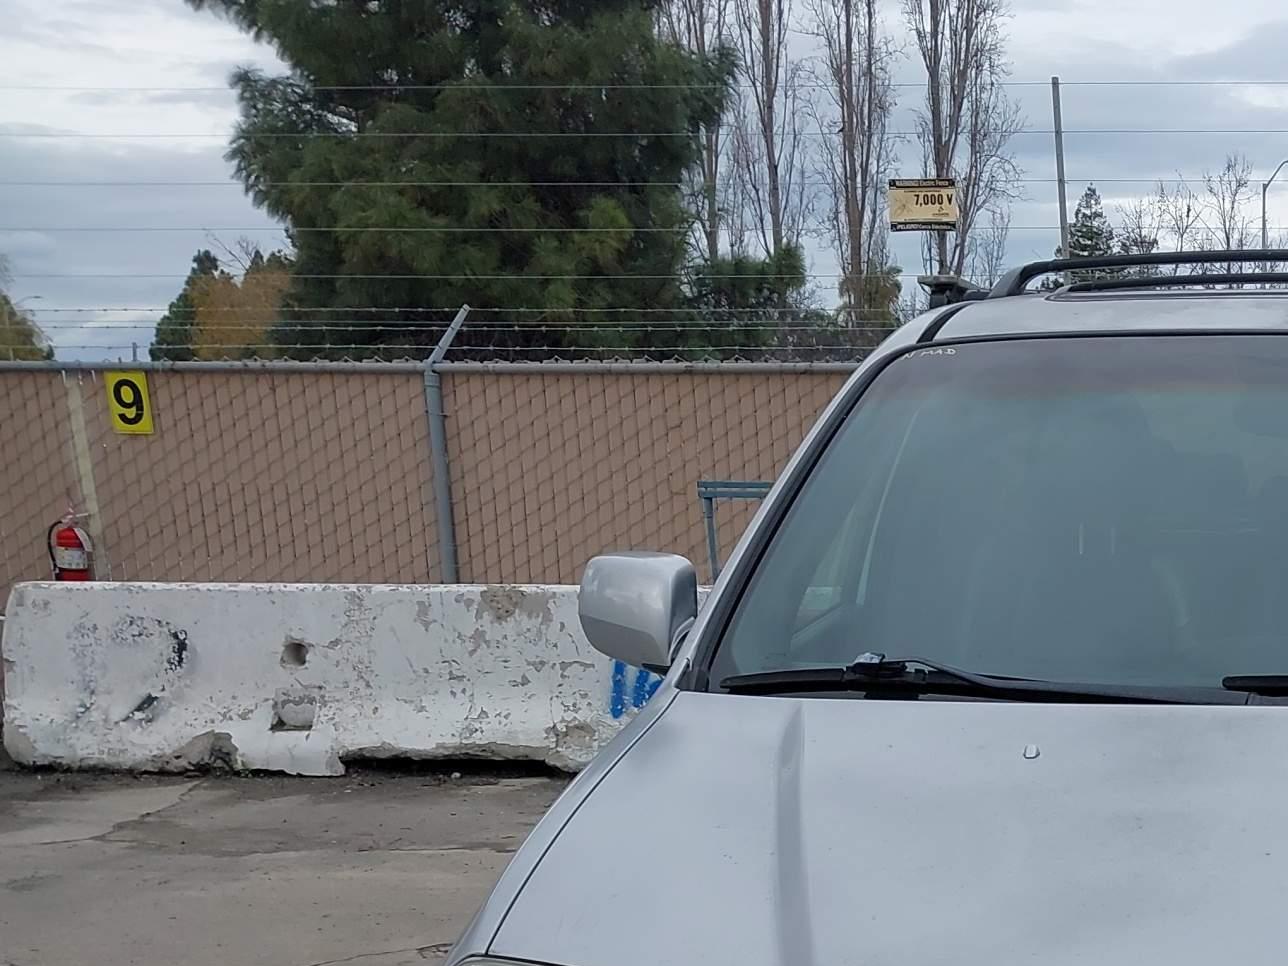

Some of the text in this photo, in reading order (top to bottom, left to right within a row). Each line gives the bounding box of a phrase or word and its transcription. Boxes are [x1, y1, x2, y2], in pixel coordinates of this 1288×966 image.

[914, 193, 954, 207] 7,000 V
[113, 379, 145, 426] 9
